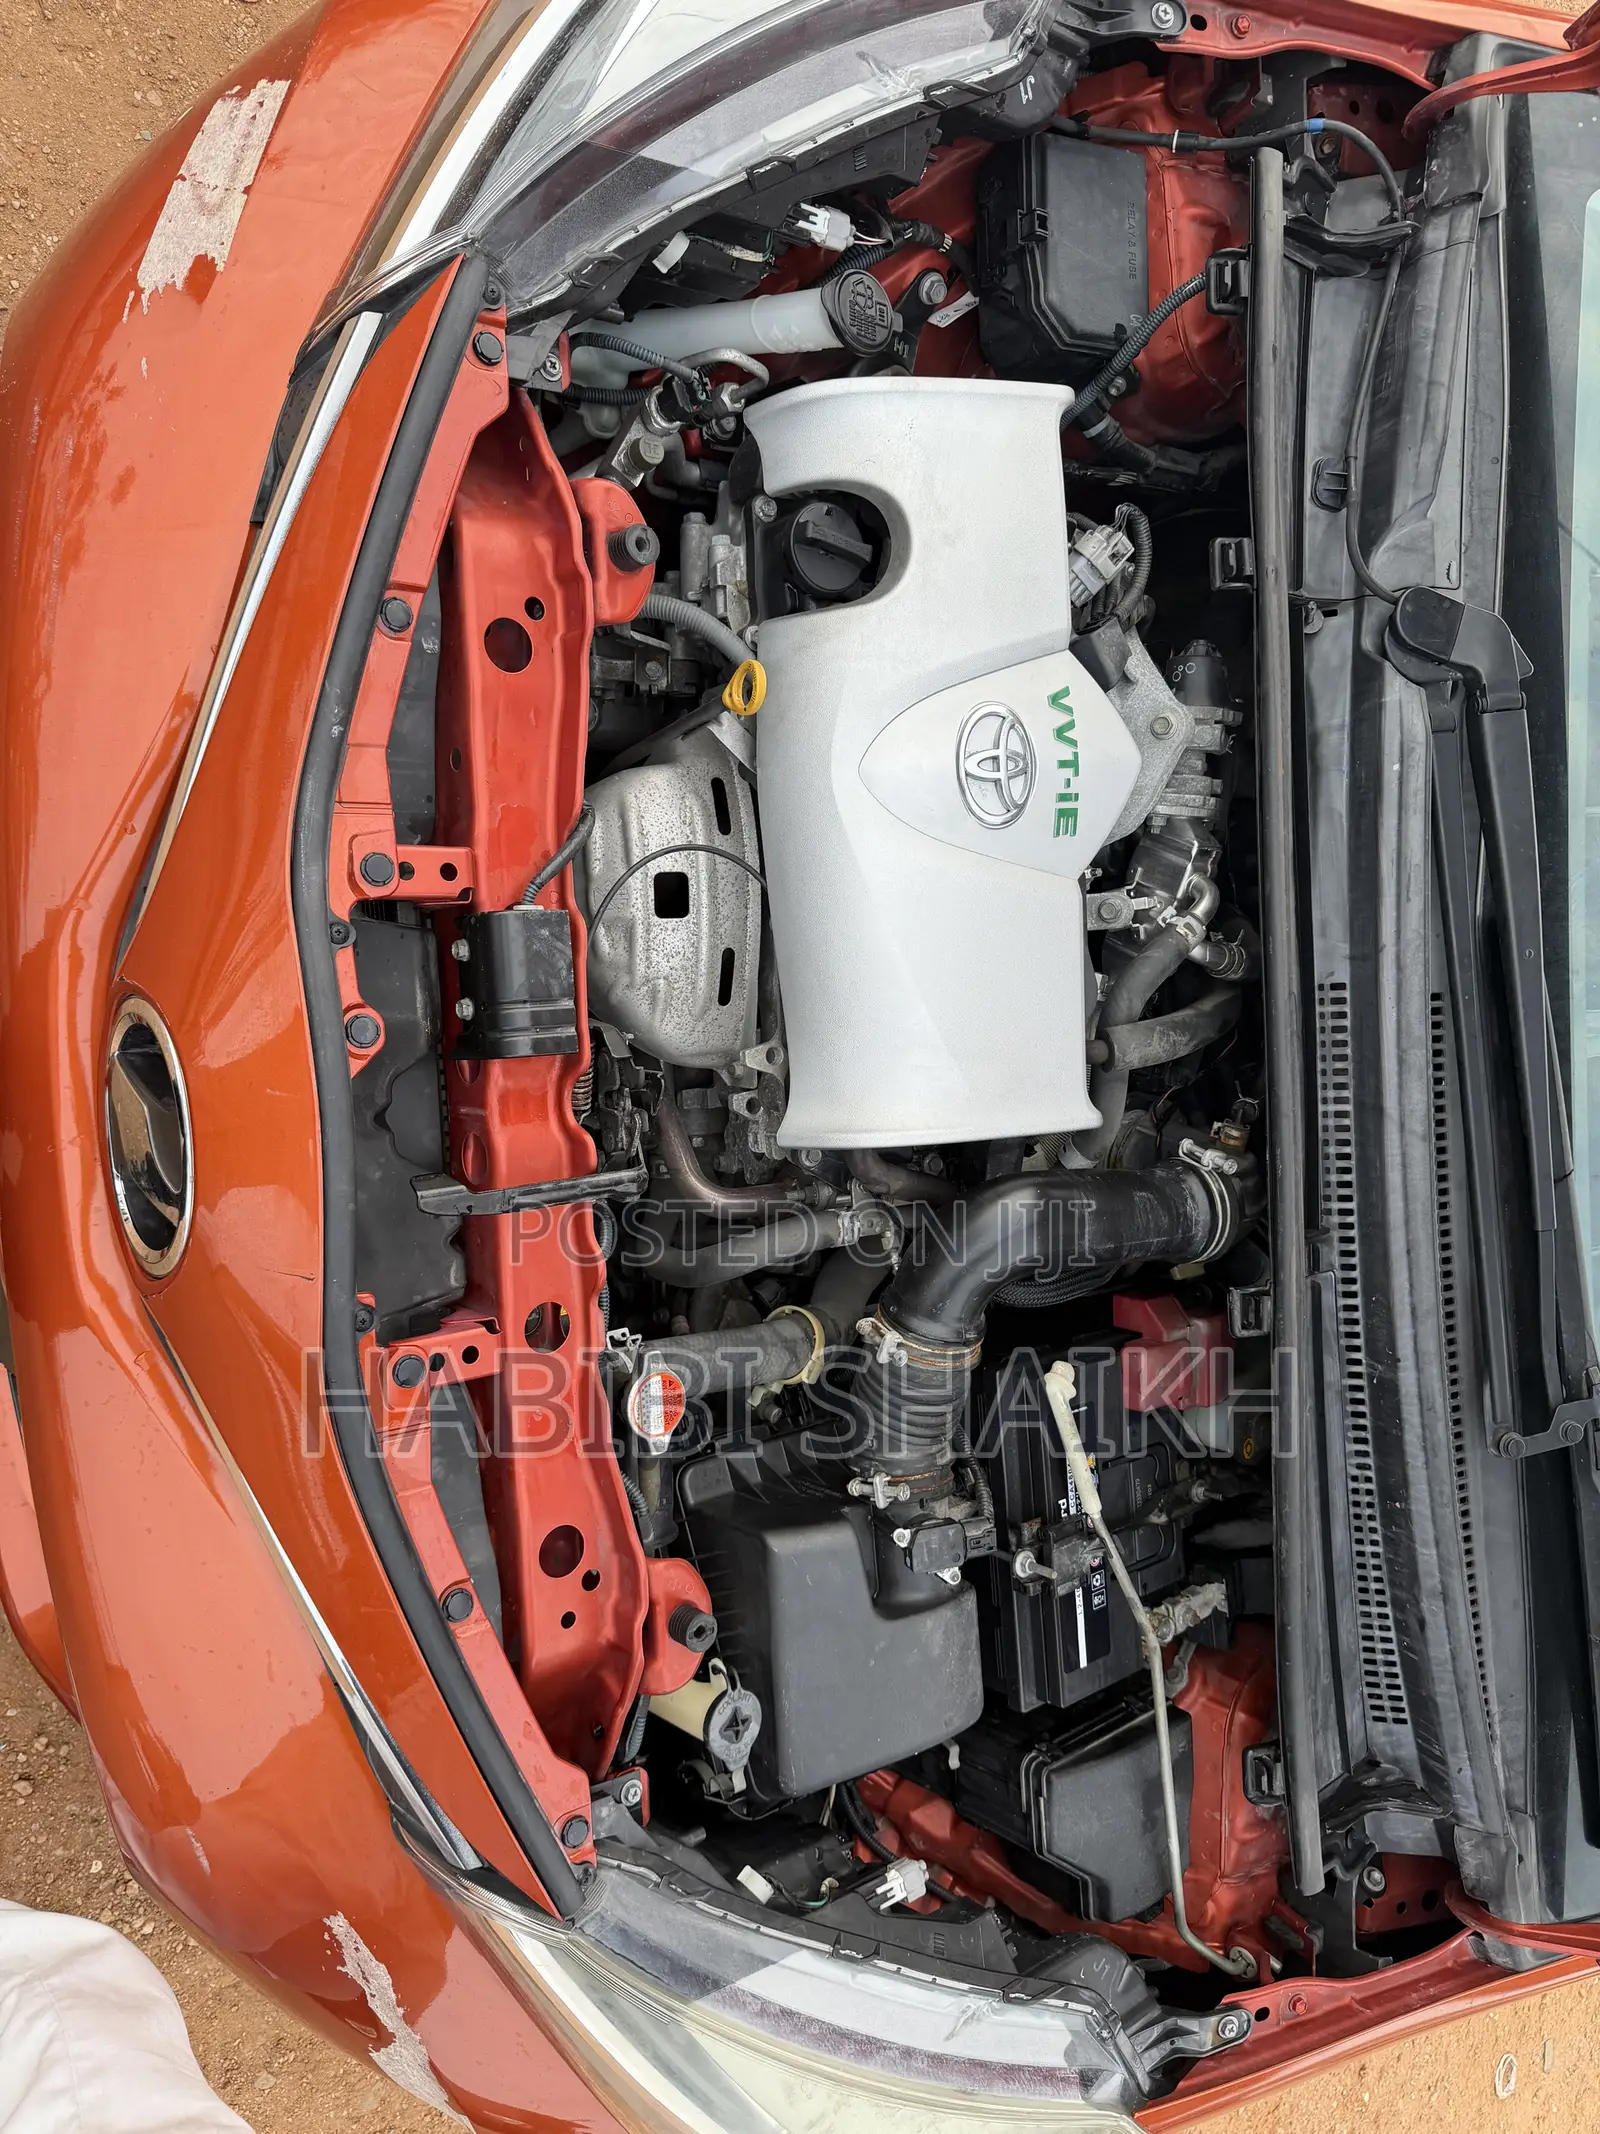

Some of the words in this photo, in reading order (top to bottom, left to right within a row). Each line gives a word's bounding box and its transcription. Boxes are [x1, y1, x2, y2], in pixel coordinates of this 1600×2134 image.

[1127, 201, 1136, 237] RELAY
[1128, 240, 1137, 248] &
[1128, 251, 1137, 280] FUSE
[1046, 685, 1080, 839] VVT-iE
[1068, 1463, 1076, 1508] CCA480
